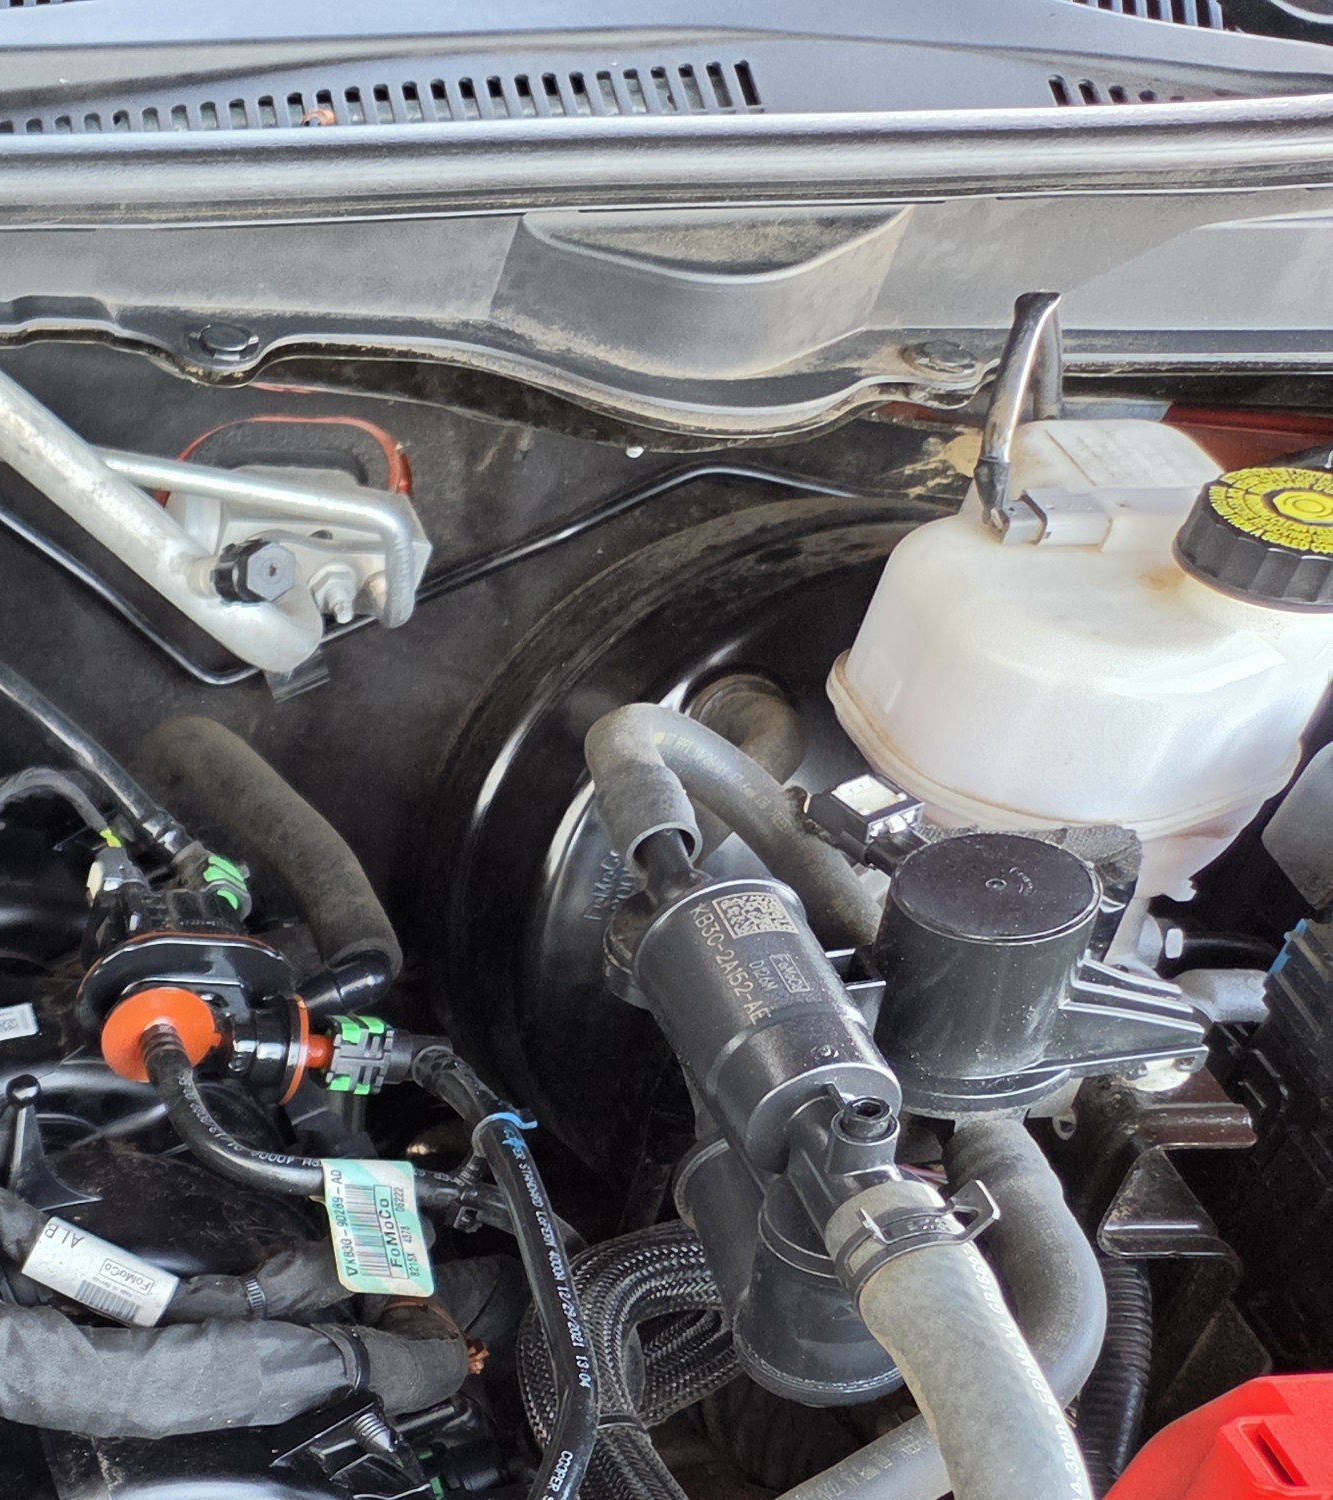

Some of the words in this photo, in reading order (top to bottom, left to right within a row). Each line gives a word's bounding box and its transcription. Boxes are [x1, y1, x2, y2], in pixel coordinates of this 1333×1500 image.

[378, 1198, 403, 1268] FoMoCo
[105, 1263, 152, 1291] FoMoCo
[547, 1450, 574, 1493] COOPER
